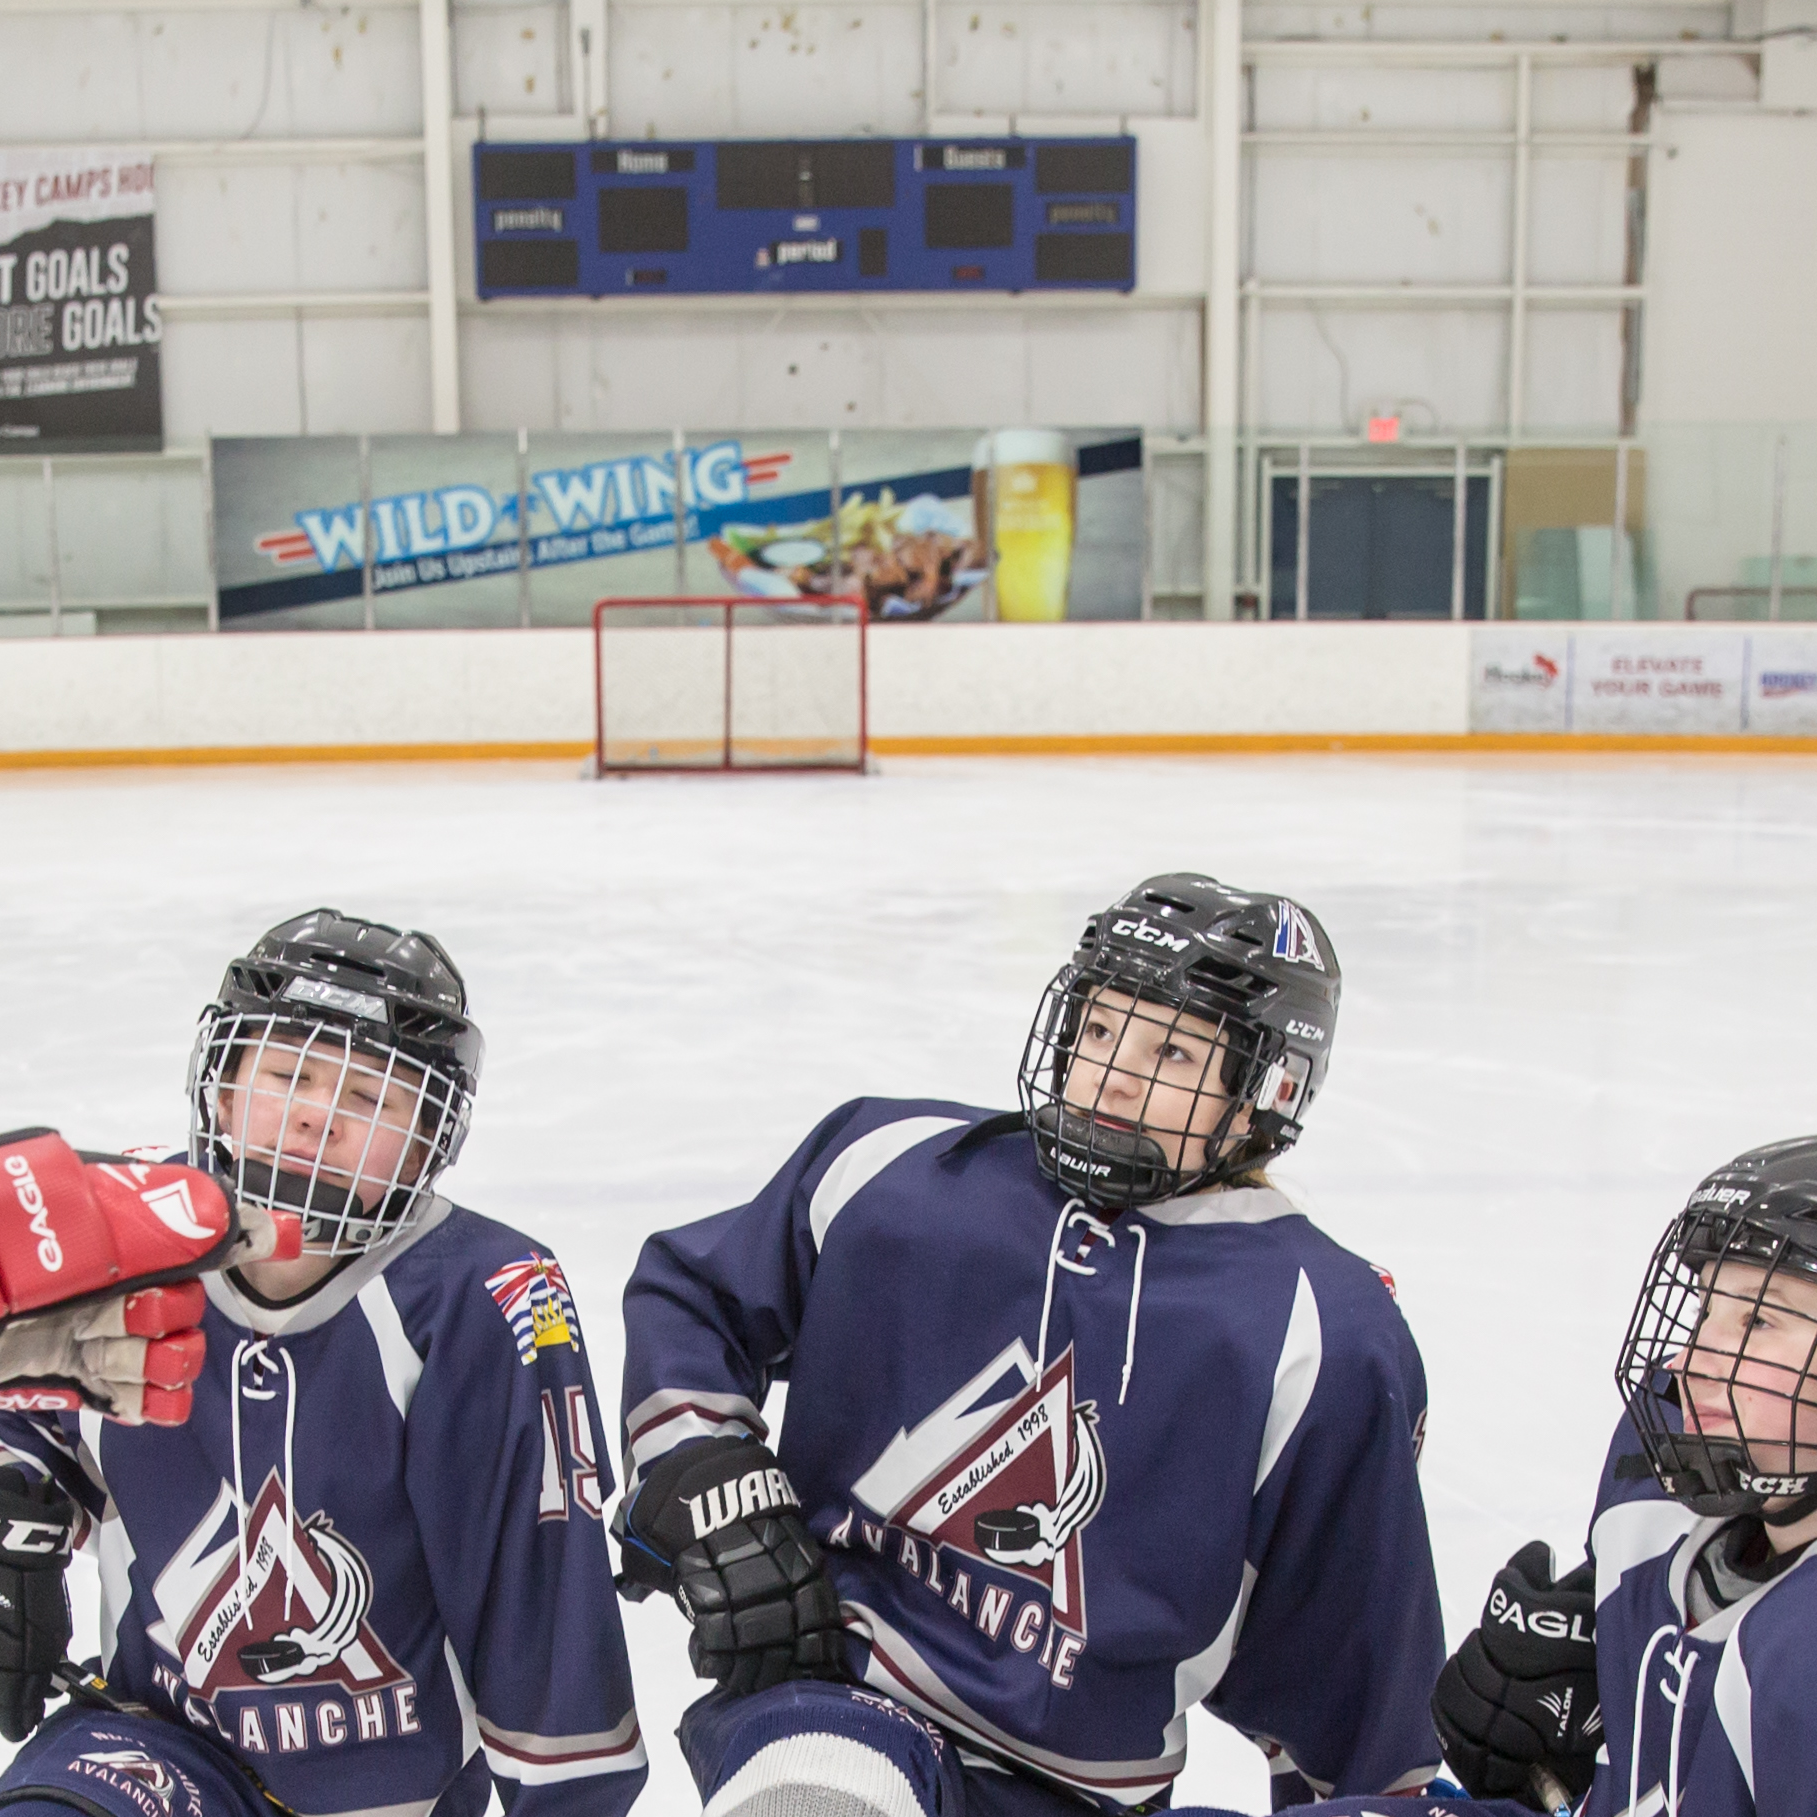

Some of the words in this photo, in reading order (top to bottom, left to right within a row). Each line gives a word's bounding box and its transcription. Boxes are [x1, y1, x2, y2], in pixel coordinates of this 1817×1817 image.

[34, 168, 112, 206] CAMPS
[25, 242, 131, 301] GOALS
[777, 236, 838, 266] period
[61, 294, 163, 352] GOALS
[295, 483, 499, 576] WILD
[533, 440, 749, 533] WING
[1590, 677, 1652, 699] YOUR
[1657, 677, 1723, 699] GAME
[1610, 656, 1704, 676] ELEVATE
[1112, 917, 1189, 954] CCM
[1285, 1018, 1325, 1042] CCM
[936, 1438, 1015, 1517] Established
[1015, 1402, 1052, 1443] 1998
[197, 1575, 258, 1663] Establised
[255, 1535, 274, 1573] 1998
[1489, 1587, 1596, 1643] eAGL
[1557, 1686, 1573, 1738] TALON
